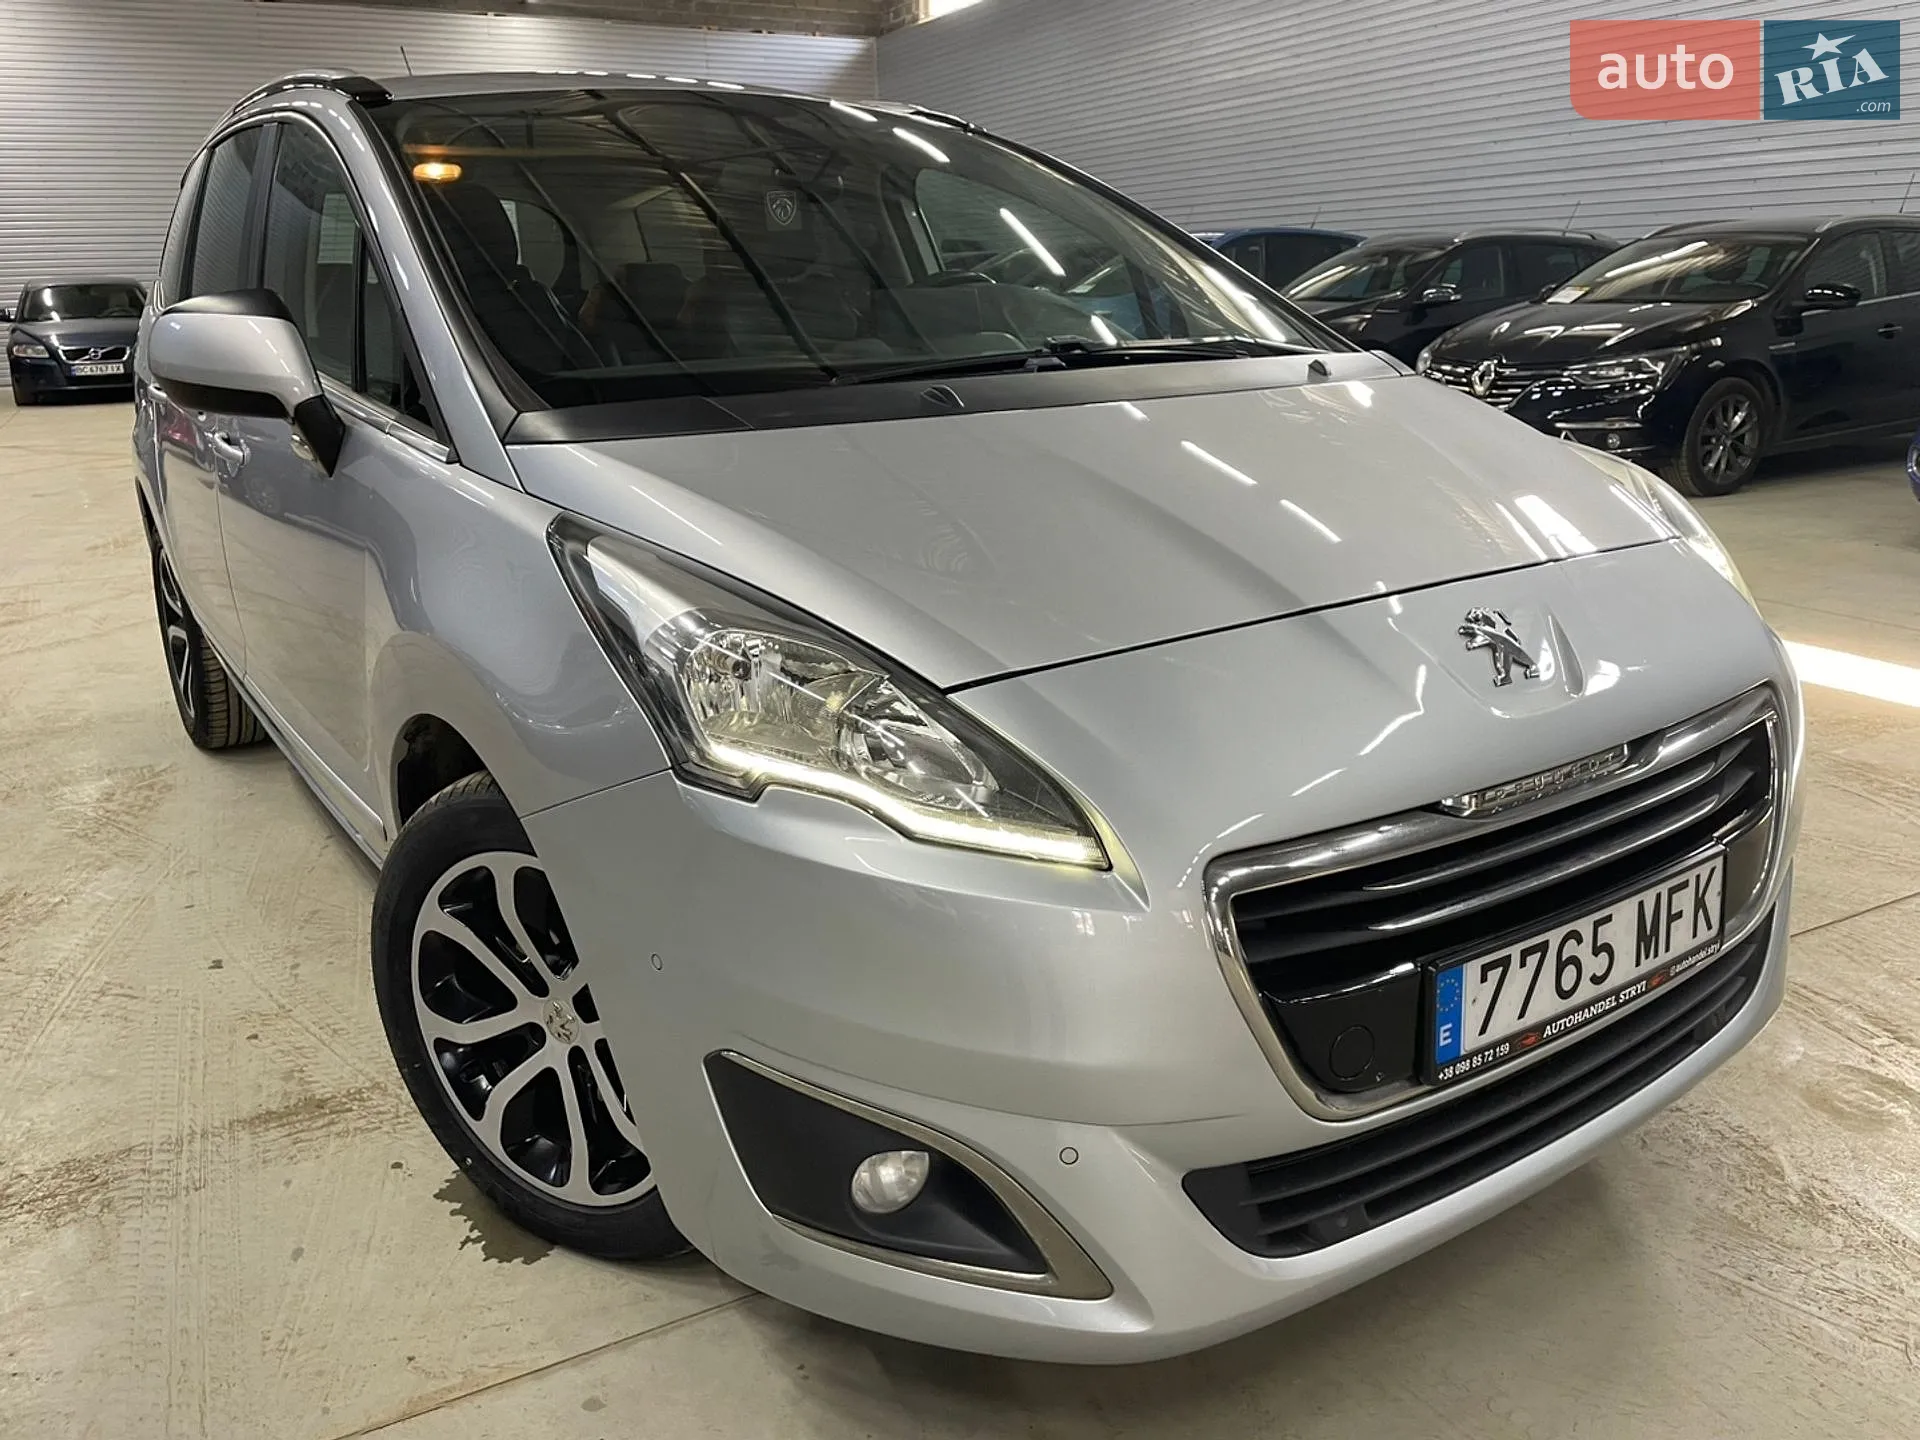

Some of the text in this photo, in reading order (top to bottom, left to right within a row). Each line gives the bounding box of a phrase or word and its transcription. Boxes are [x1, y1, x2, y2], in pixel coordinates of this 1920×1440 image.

[1478, 866, 1718, 1037] 7765 MFK
[1542, 980, 1647, 1039] AUTOHANDEL STRYI
[1439, 1023, 1453, 1046] E
[1472, 1053, 1483, 1069] 85
[1484, 1049, 1494, 1063] 72
[1495, 1042, 1510, 1058] 159
